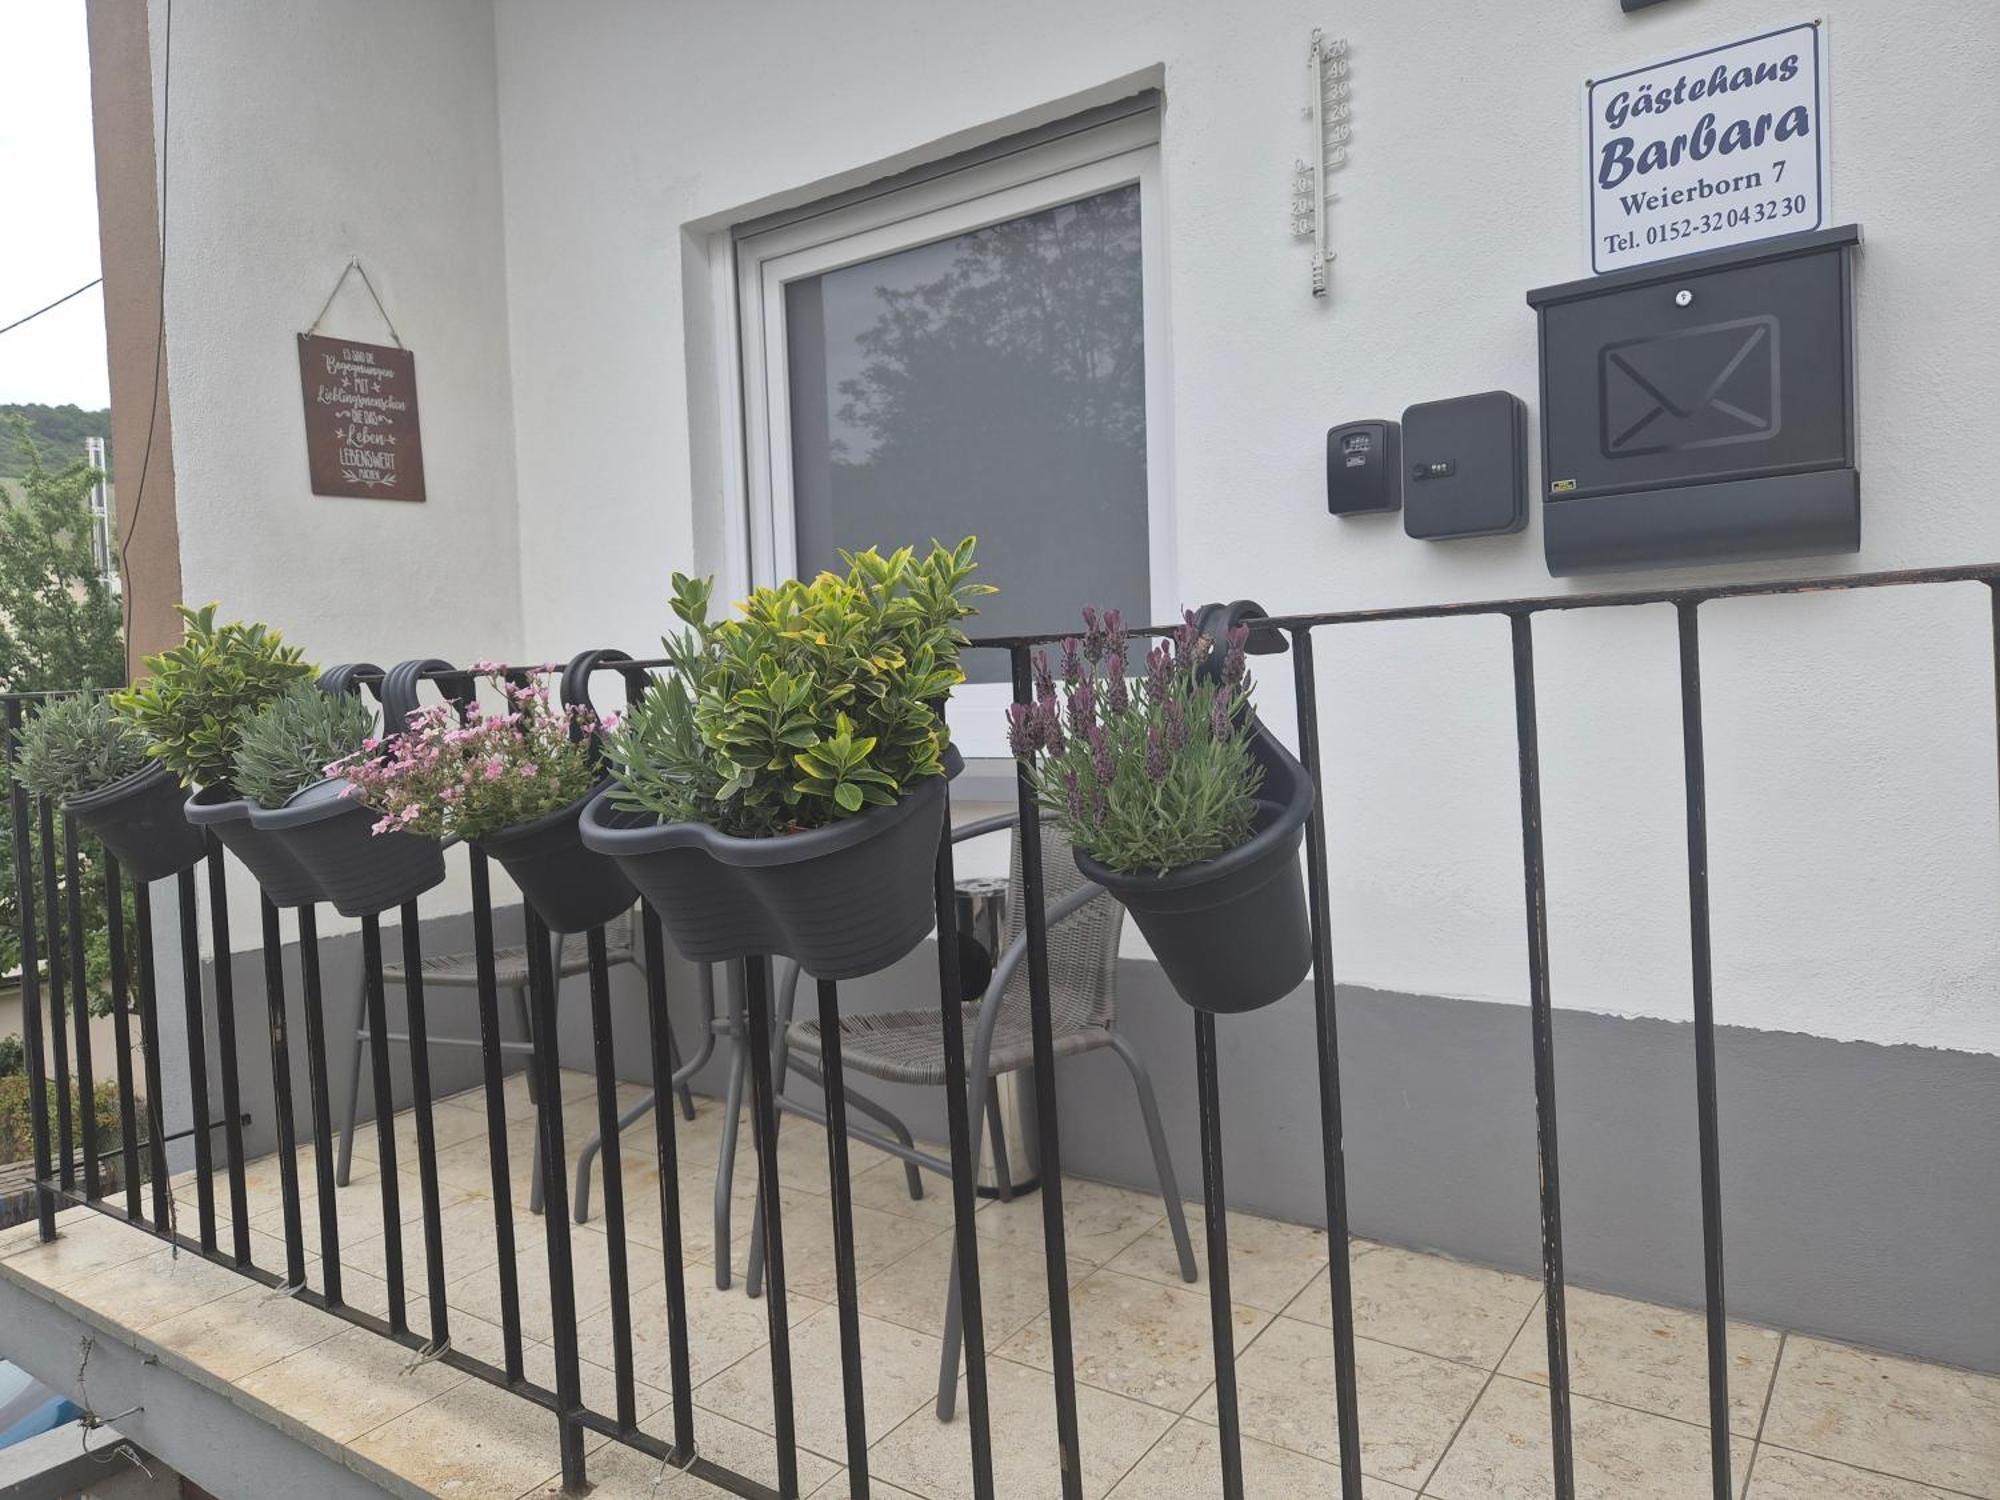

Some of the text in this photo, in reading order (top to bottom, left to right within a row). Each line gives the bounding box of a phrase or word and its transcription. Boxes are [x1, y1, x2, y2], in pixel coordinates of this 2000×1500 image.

[1605, 54, 1799, 130] Gästehaus
[1598, 105, 1810, 190] Barbara
[1619, 160, 1786, 216] Weierborn 7
[1604, 232, 1641, 254] Tel.
[347, 423, 385, 449] Leben
